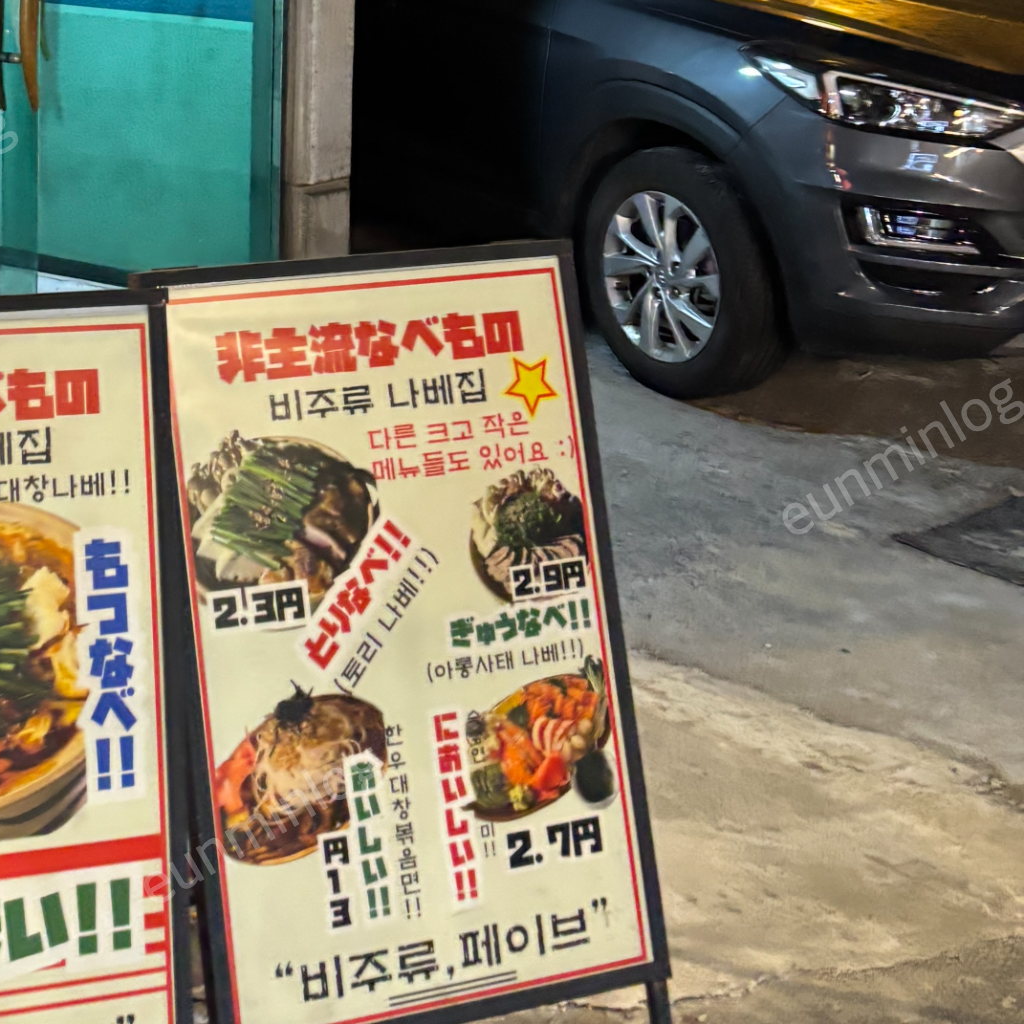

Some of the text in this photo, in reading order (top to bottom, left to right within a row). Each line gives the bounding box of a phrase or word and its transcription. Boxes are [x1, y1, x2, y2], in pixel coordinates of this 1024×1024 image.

[216, 311, 524, 384] 非主流なべもの
[269, 369, 488, 422] 비주류 나베집
[367, 411, 530, 450] 다른 크고 작은
[372, 450, 471, 481] 메뉴들도
[479, 441, 549, 471] 있어요
[304, 519, 412, 670] とりなべ!!
[512, 560, 586, 597] 2.9円
[212, 587, 307, 630] 2.3円
[85, 538, 137, 791] もつなべ!!
[334, 632, 383, 696] (토리
[506, 816, 603, 869] 2.7円
